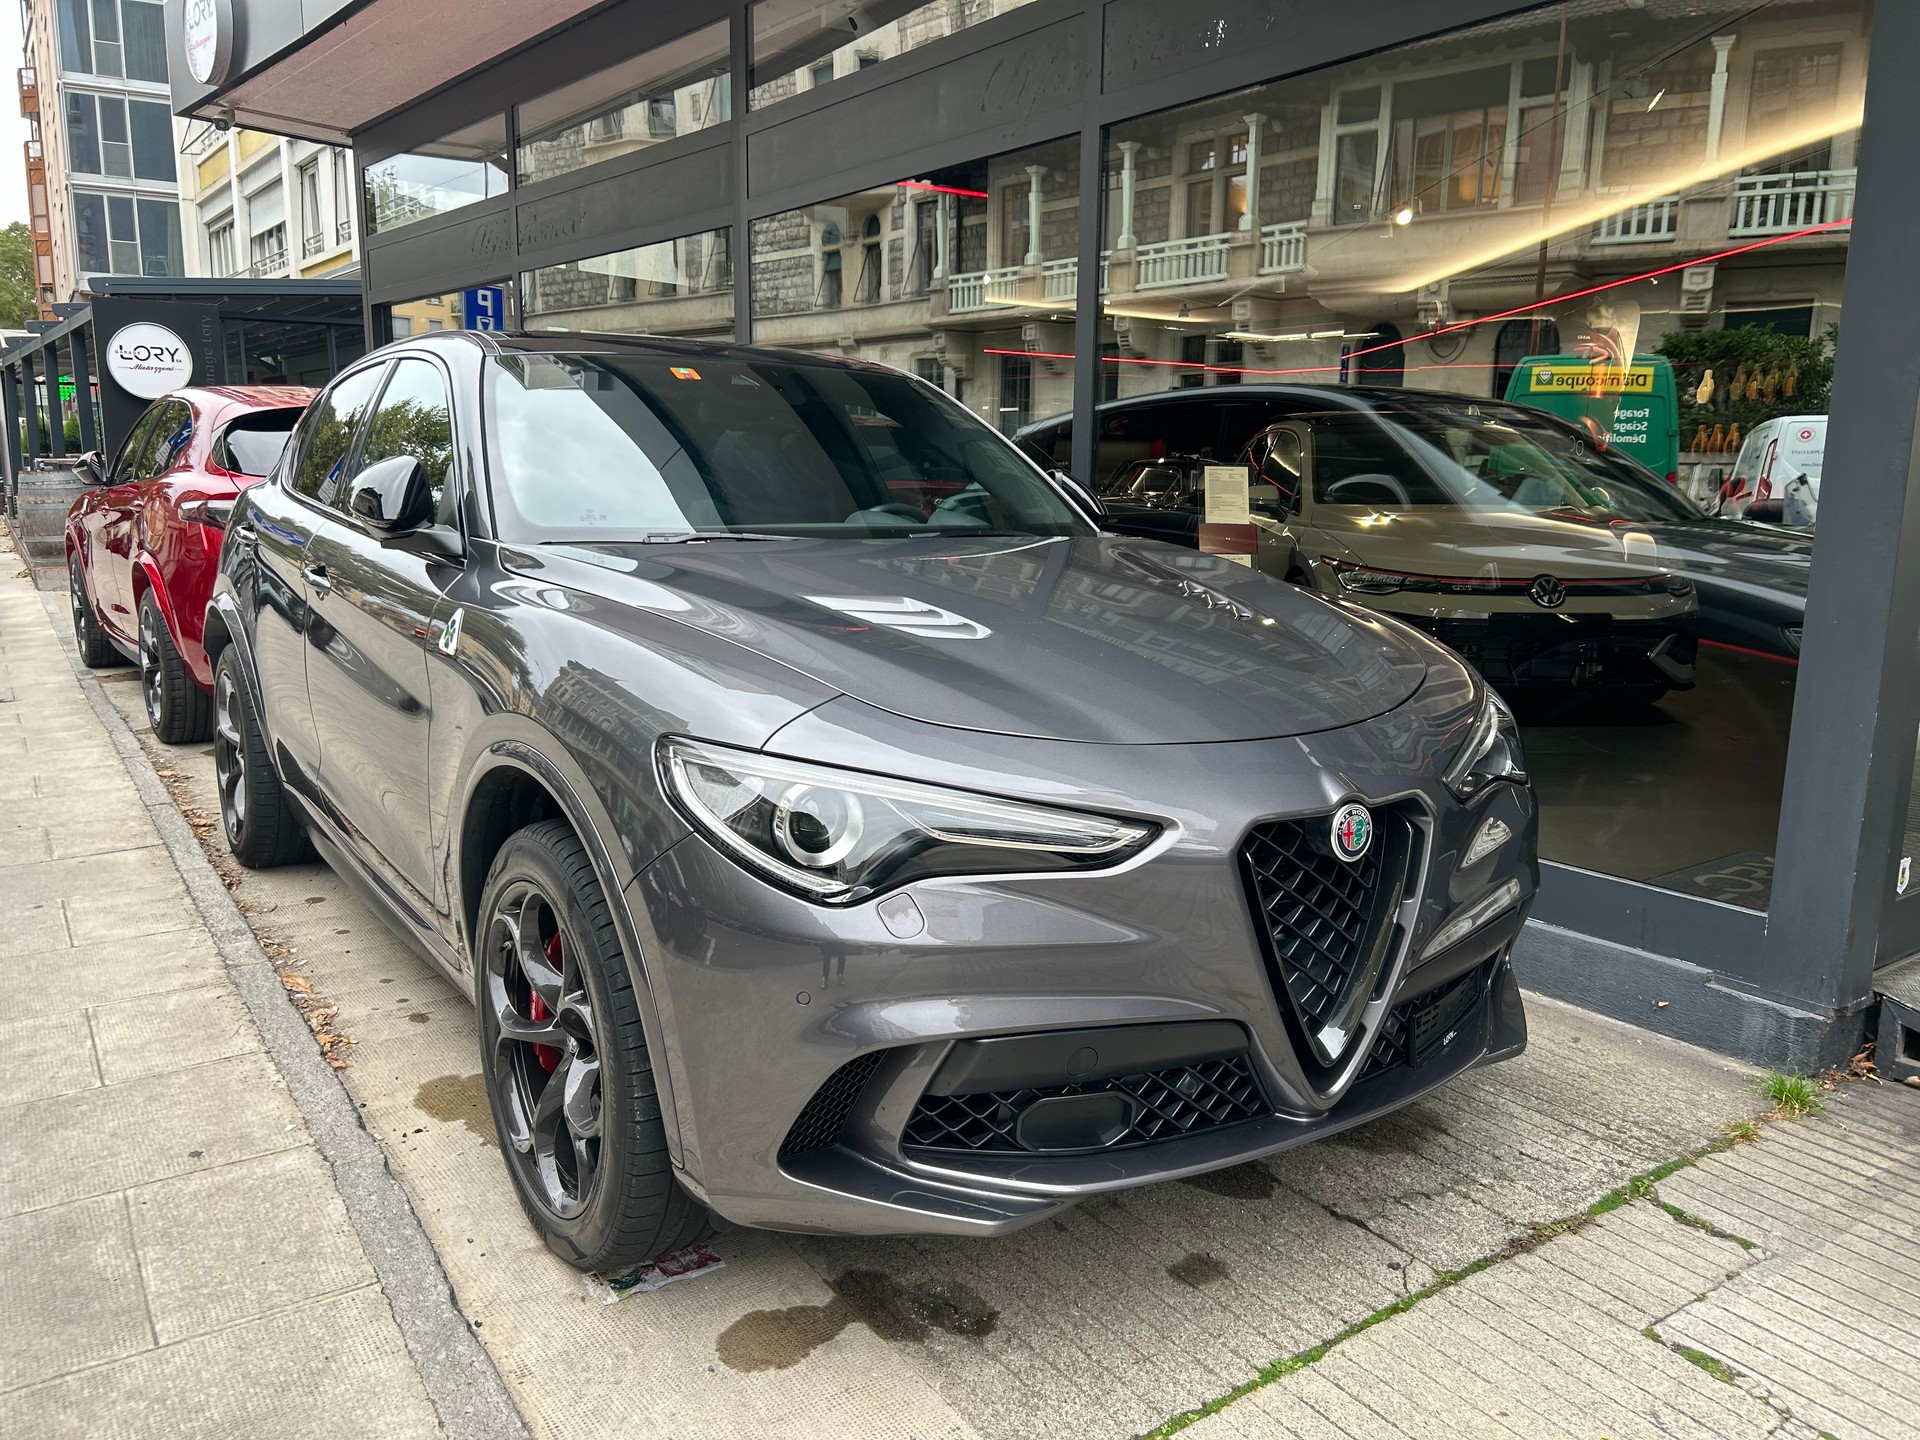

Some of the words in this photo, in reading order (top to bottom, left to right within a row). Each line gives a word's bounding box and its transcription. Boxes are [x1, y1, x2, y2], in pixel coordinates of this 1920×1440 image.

[200, 314, 214, 343] Lory
[119, 344, 180, 362] LORY
[203, 346, 217, 386] arage
